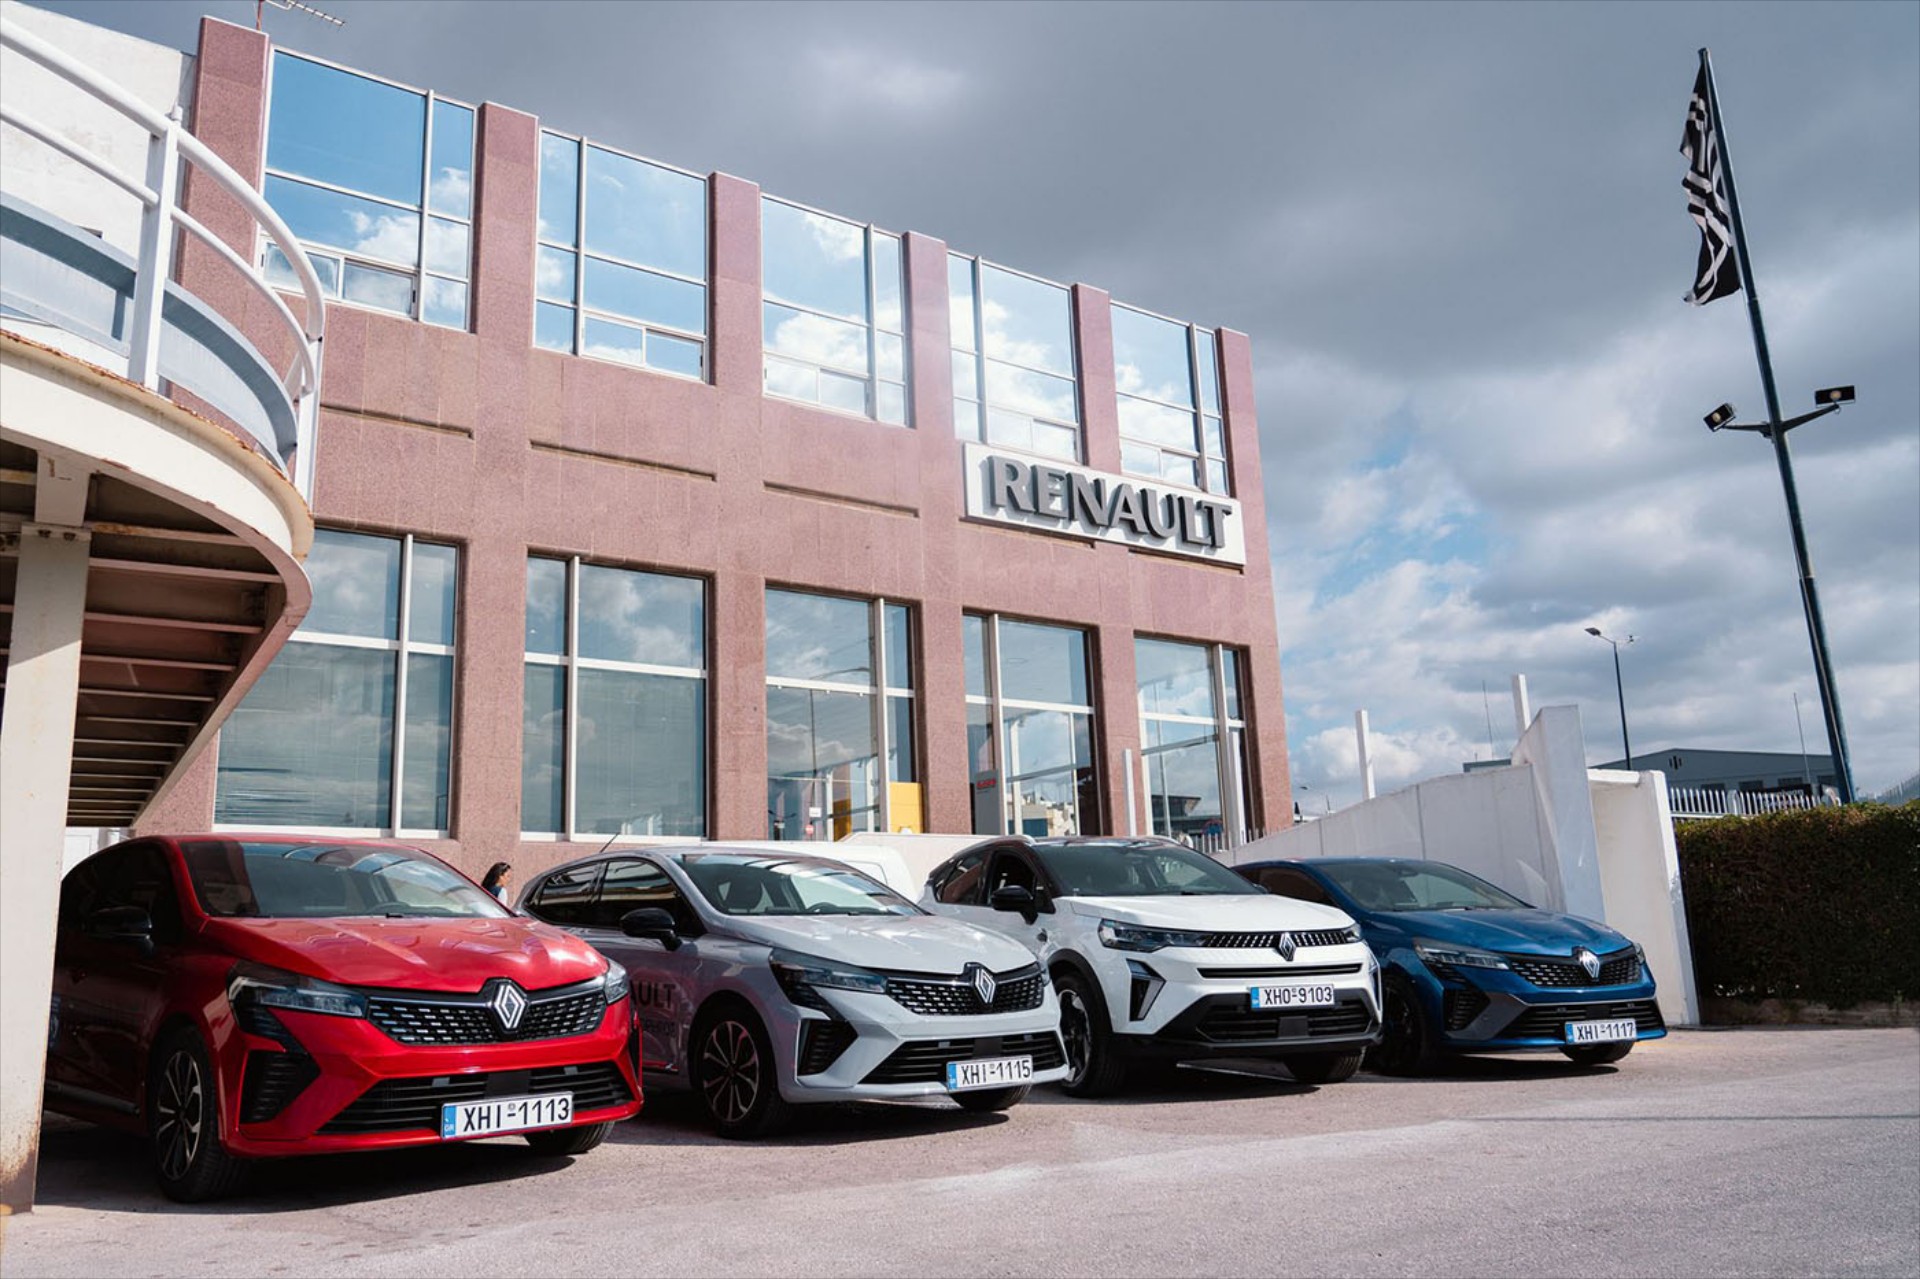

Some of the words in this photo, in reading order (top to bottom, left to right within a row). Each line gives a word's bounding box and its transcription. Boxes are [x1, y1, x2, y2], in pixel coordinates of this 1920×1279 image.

[987, 455, 1233, 548] RENAULT
[1263, 986, 1333, 1005] XHO-9103
[1576, 1021, 1634, 1041] XHI-1117
[961, 1059, 1031, 1085] XHI-1115
[463, 1097, 570, 1132] XHI-1113
